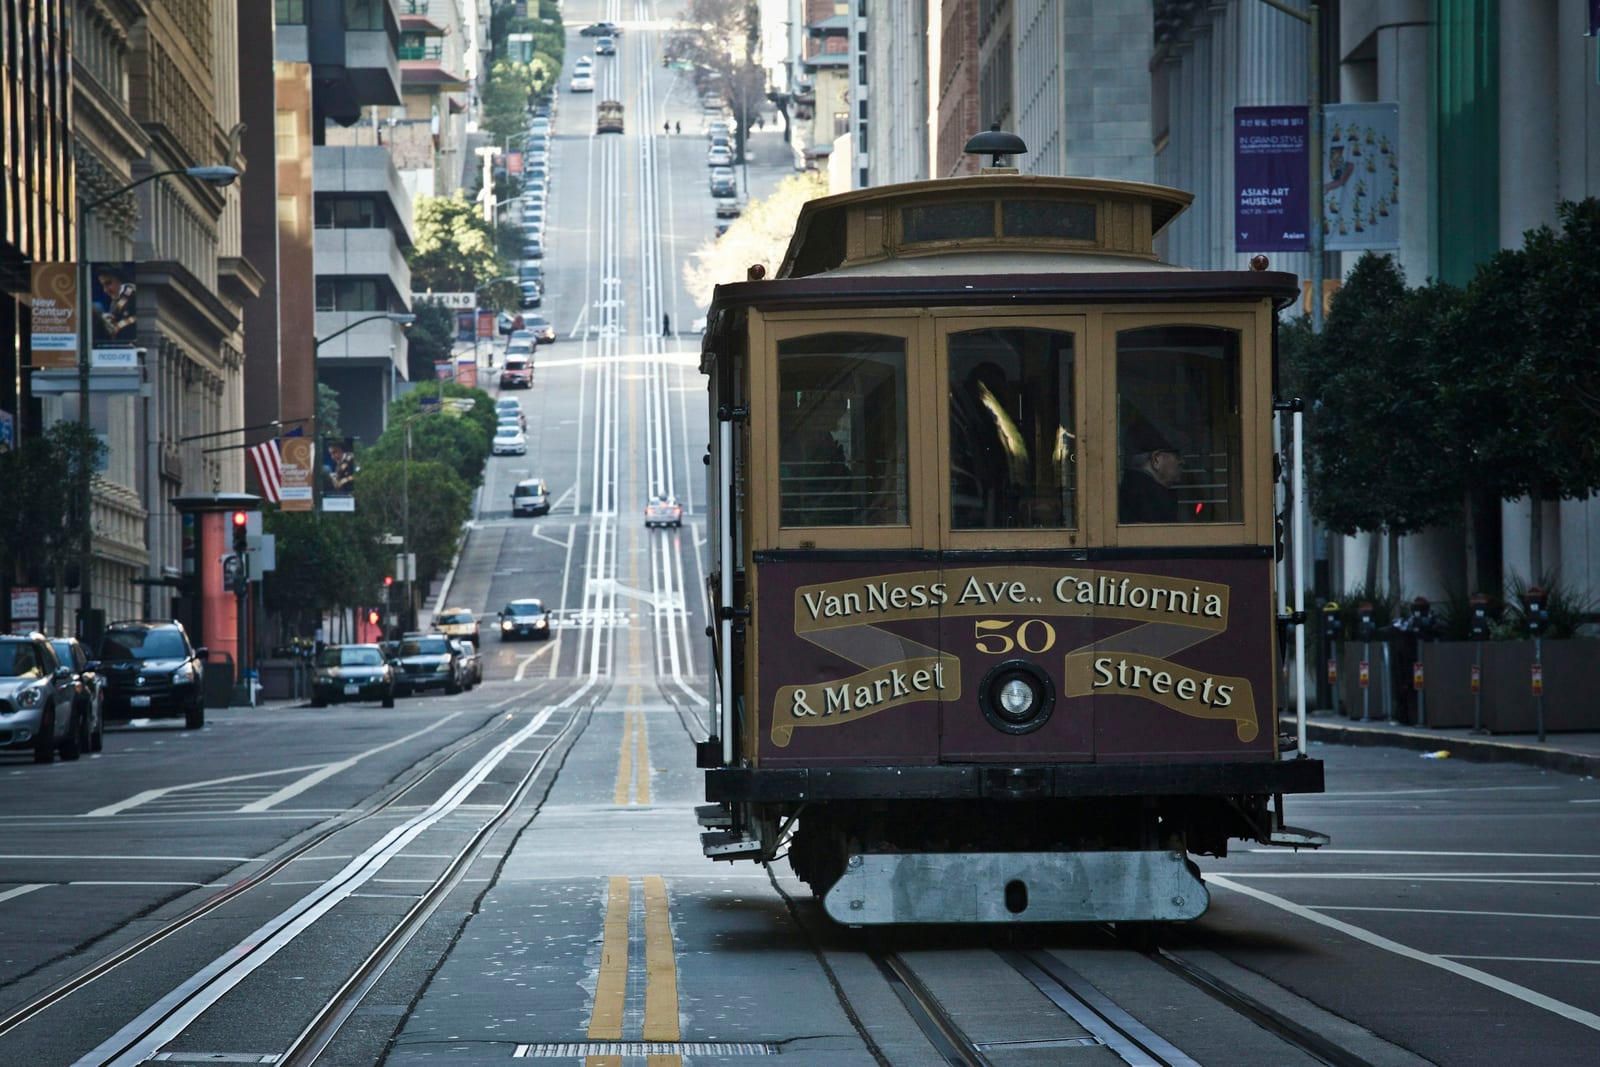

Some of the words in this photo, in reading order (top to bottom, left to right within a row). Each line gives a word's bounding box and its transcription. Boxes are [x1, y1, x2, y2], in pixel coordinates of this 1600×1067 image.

[1249, 136, 1279, 144] GRAND
[1280, 135, 1303, 144] STYLE
[1241, 188, 1270, 197] ASIAN
[1271, 187, 1290, 196] ART
[1241, 197, 1282, 206] MUSEUM
[31, 298, 57, 307] New
[31, 307, 73, 319] Century
[803, 589, 861, 619] Van
[866, 581, 948, 612] Ness
[1056, 575, 1223, 618] California
[976, 619, 1056, 654] 50
[1093, 658, 1234, 706] Streets
[792, 688, 817, 717] &
[825, 662, 946, 714] Market
